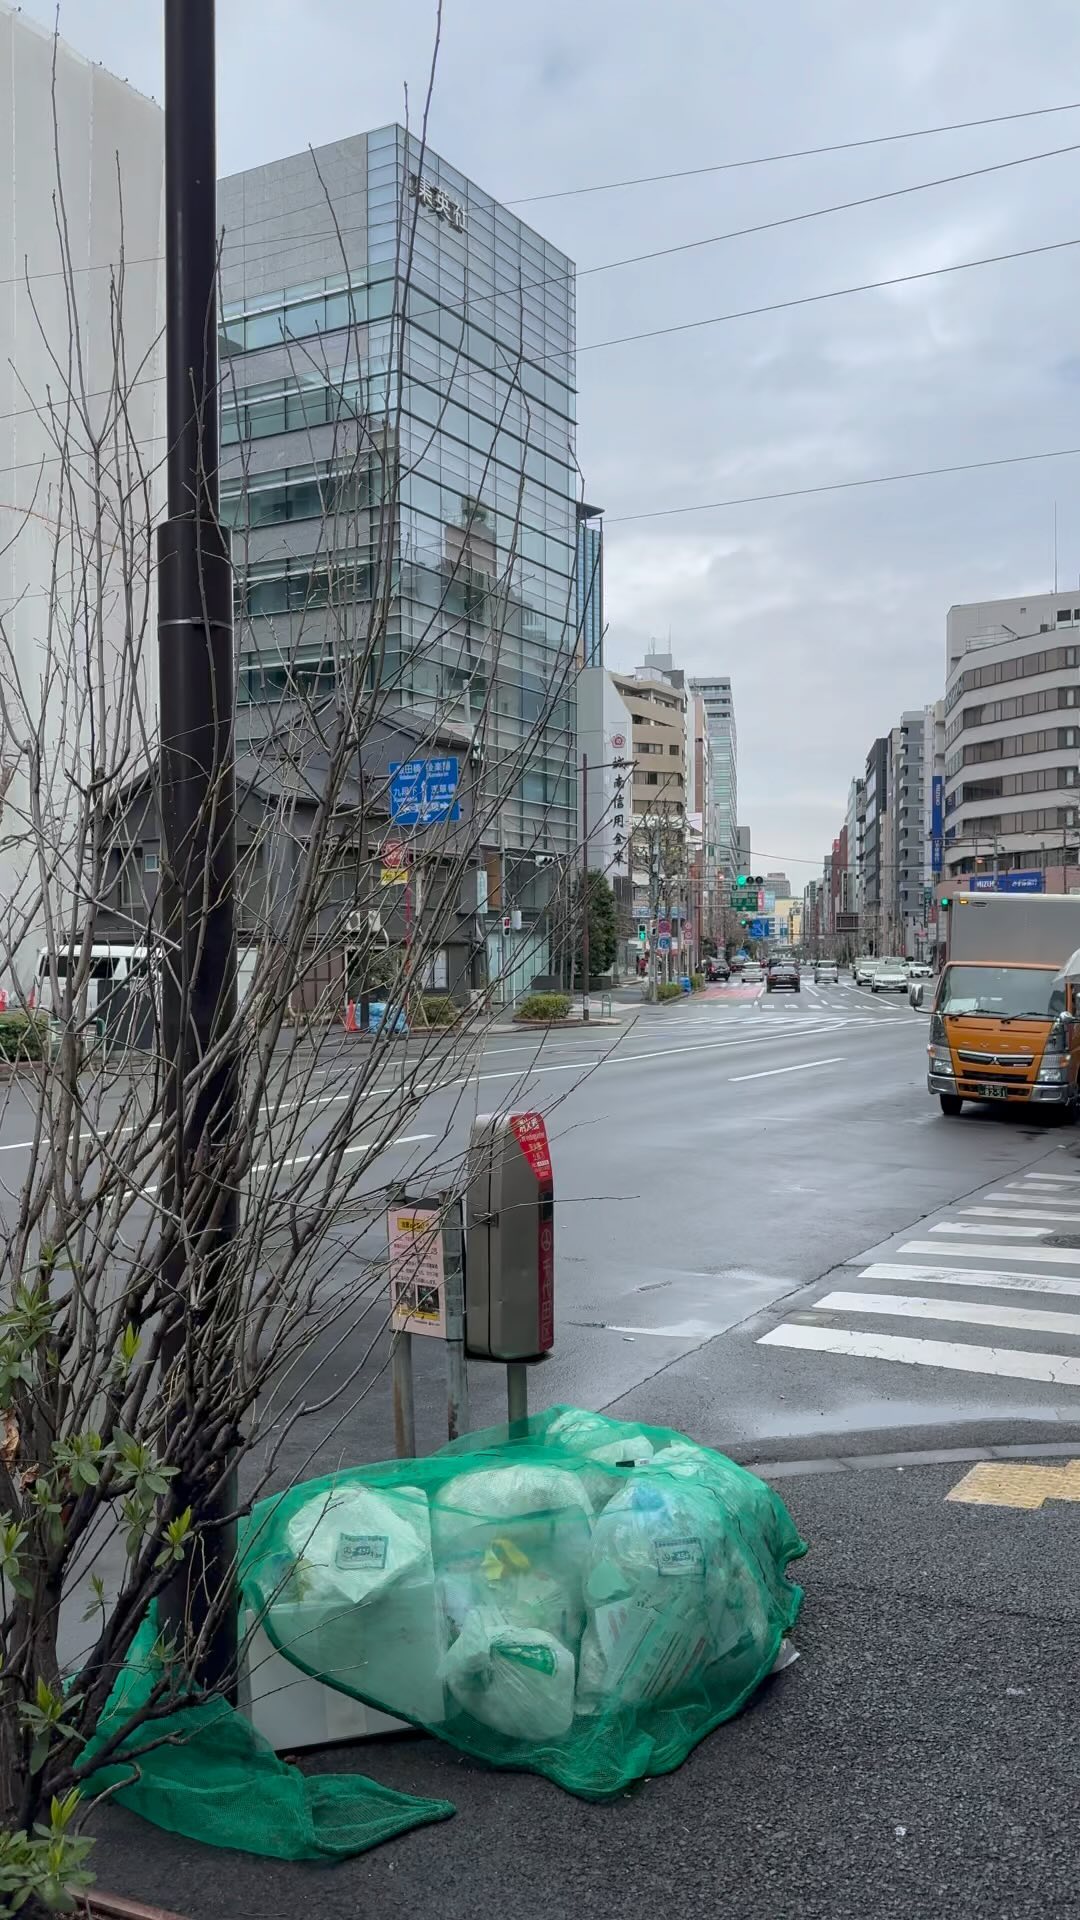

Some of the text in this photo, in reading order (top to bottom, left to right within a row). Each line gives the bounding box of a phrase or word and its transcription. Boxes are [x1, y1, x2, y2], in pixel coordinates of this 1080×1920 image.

[612, 756, 627, 867] 城南信用金庫
